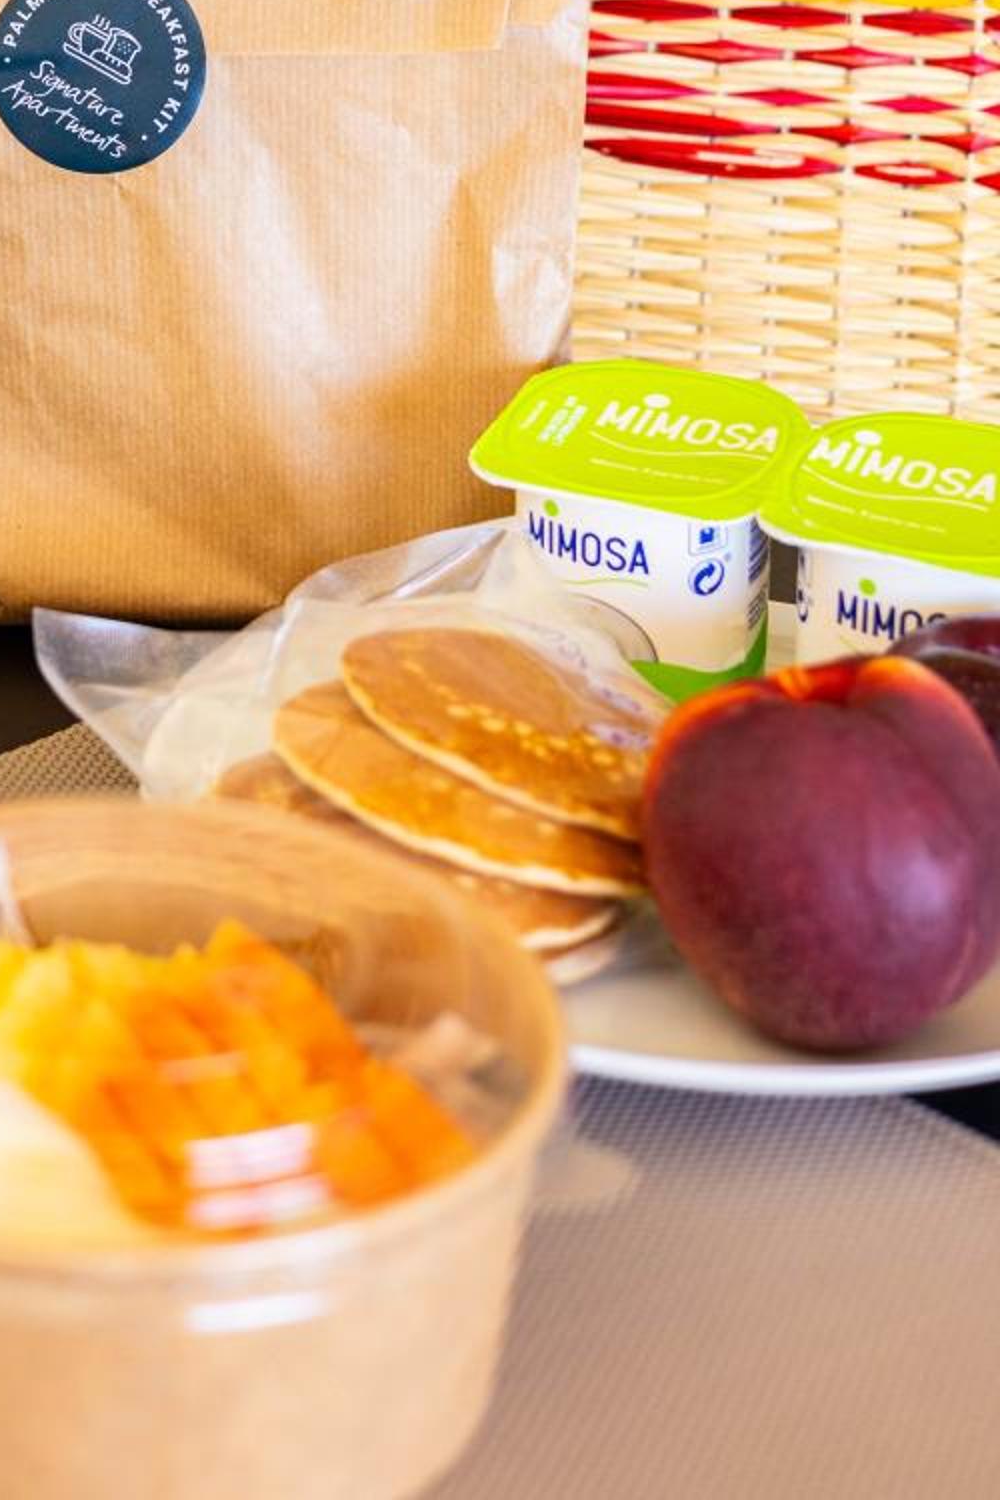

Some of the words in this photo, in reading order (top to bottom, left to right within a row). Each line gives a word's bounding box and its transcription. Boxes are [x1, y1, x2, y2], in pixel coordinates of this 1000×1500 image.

[1, 79, 128, 159] Apartments
[29, 60, 124, 125] Signature
[153, 97, 181, 133] KIT
[596, 393, 780, 453] MIMOSA
[807, 429, 997, 504] MIMOSA
[528, 499, 651, 576] MIMOSA
[836, 578, 948, 641] MIMO
